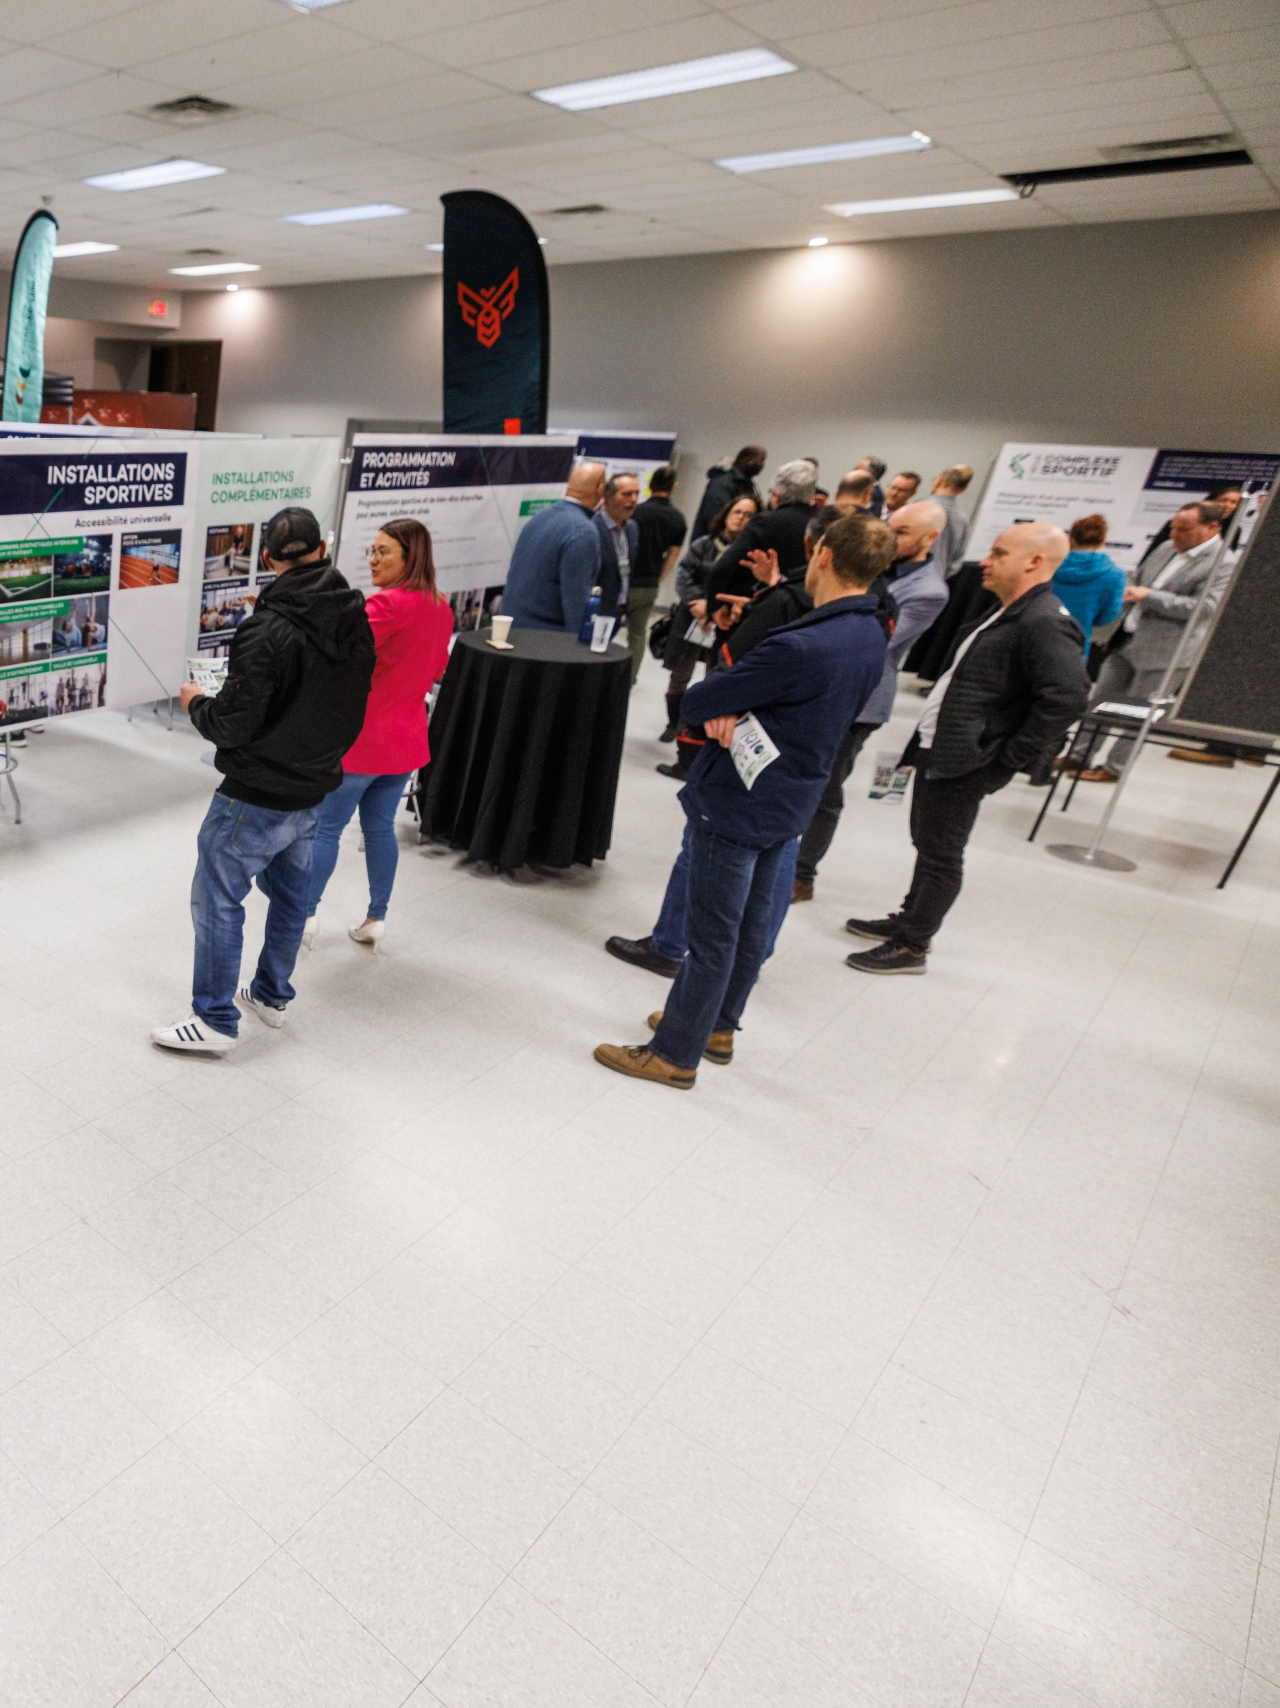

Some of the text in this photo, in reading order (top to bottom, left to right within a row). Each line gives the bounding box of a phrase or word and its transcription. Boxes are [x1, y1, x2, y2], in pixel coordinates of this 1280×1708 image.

[362, 451, 456, 468] PROGRAMMATION
[1044, 453, 1121, 465] COMPLEXE
[47, 463, 175, 485] INSTALLATIONS
[212, 470, 295, 485] INSTALLATIONS
[359, 468, 430, 488] ET ACTIVITÉS
[1040, 464, 1117, 477] SPORTIF
[84, 483, 174, 505] SPORTIVES
[211, 486, 312, 503] COMPLÉMENTAIRES
[358, 499, 399, 508] Programmation
[74, 513, 172, 528] Accessibilité universelle
